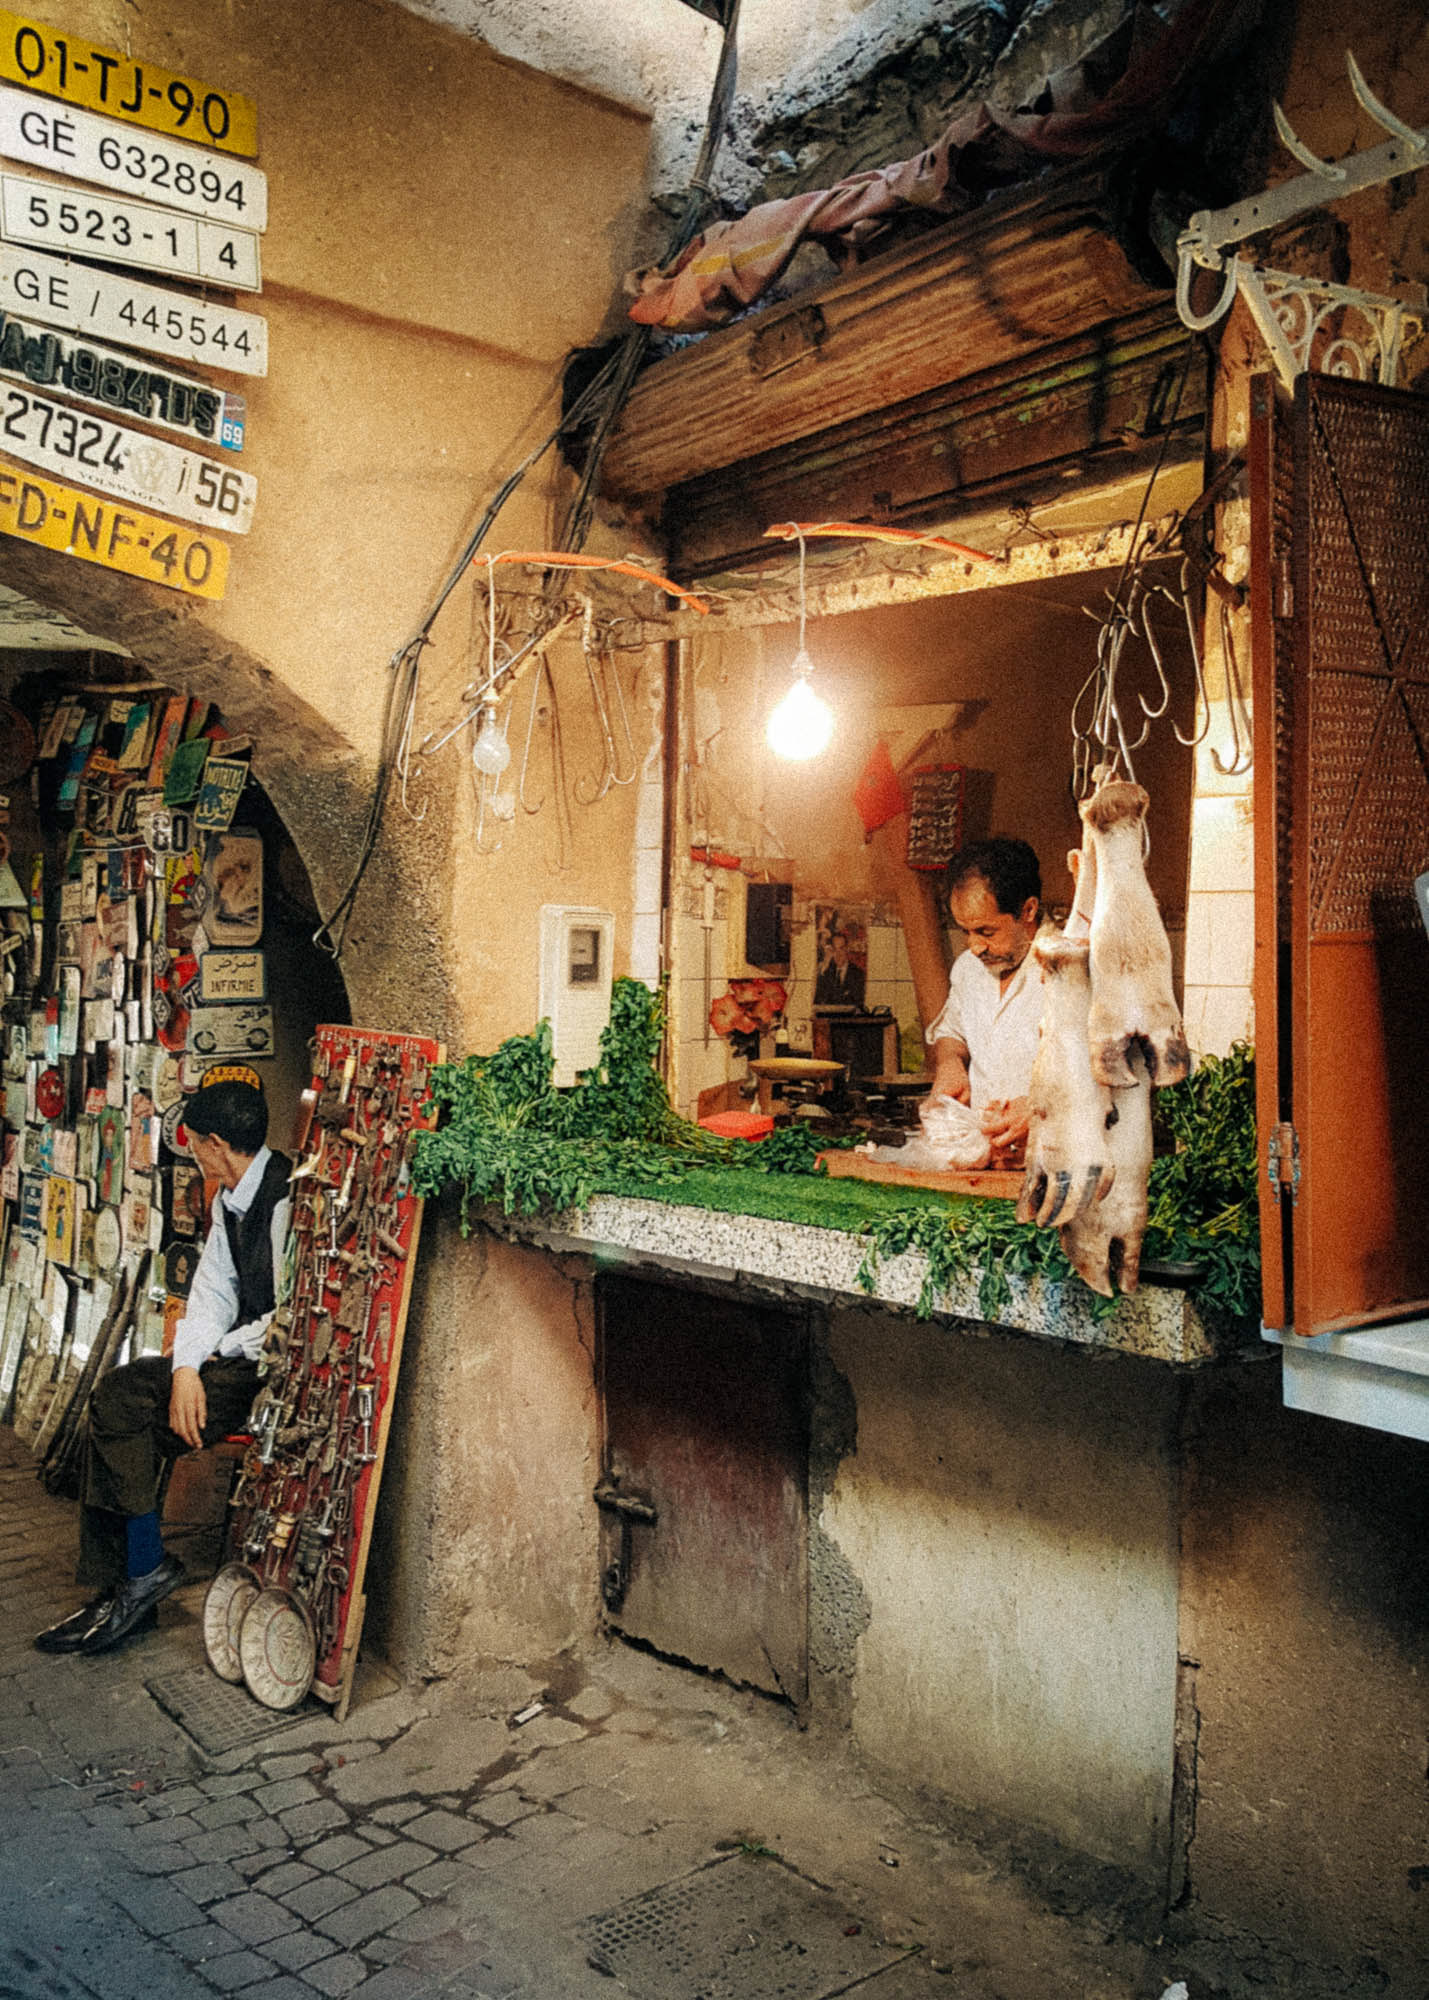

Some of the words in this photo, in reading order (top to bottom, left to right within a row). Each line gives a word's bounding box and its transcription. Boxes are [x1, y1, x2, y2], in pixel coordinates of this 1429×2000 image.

[19, 111, 77, 158] GE
[98, 136, 248, 212] 632894
[218, 241, 238, 271] 4
[13, 268, 70, 311] GE
[117, 299, 252, 357] 445544
[3, 390, 126, 475] 27324
[193, 462, 243, 517] 56
[221, 420, 244, 444] 69
